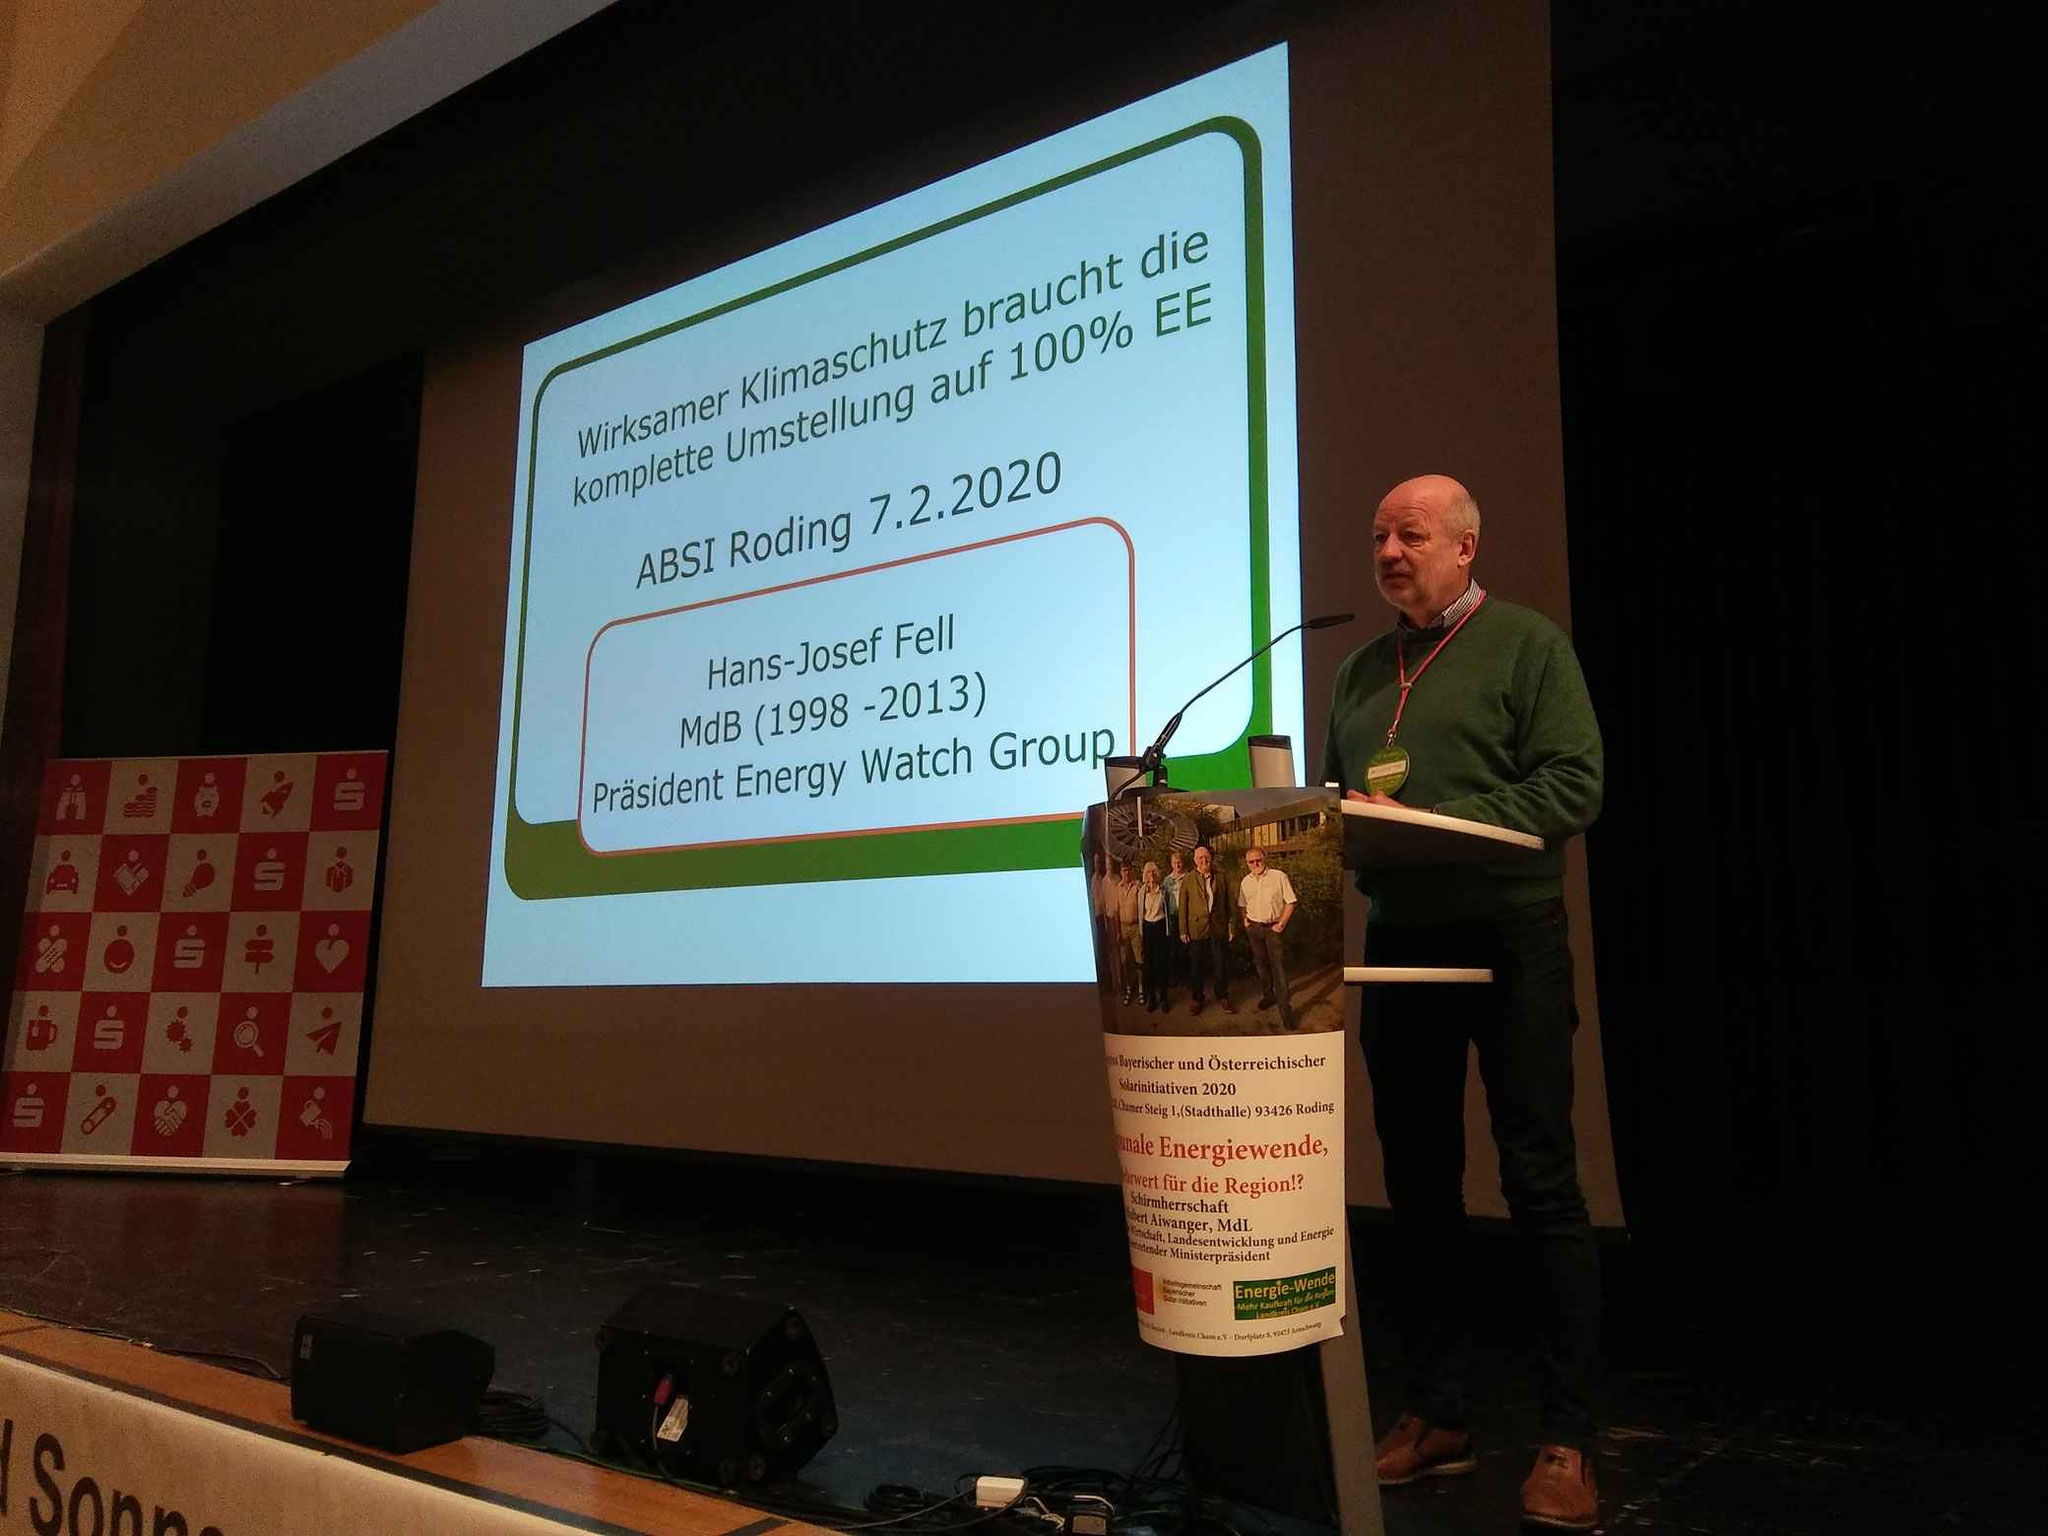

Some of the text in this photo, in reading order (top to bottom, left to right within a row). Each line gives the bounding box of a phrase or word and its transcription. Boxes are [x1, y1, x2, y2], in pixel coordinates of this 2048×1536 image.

[577, 229, 1210, 459] Wirksamer Klimaschutz braucht die
[573, 282, 1213, 508] komplette Umstellung auf 100% EE
[635, 450, 1063, 590] ABSI Roding 7.2.2020
[707, 613, 955, 691] Hans-Josef Fell
[679, 670, 987, 749] MdB (1998 -2013)
[593, 727, 1116, 813] Präsident Energy Watch Group
[1119, 1054, 1175, 1072] Bayerischer
[1178, 1056, 1204, 1071] und
[1208, 1054, 1326, 1071] Österreichischer
[1119, 1077, 1237, 1096] Solarinitiativen 2020
[1145, 1103, 1168, 1119] Steig
[1255, 1104, 1293, 1117] 93426
[1296, 1101, 1335, 1115] Roding
[1159, 1133, 1328, 1167] Energiewende,
[1122, 1166, 1304, 1199] hrwert für die Region!?
[1131, 1191, 1229, 1214] Schirmherrschaft
[1150, 1213, 1213, 1234] Aiwanger,
[1217, 1218, 1253, 1232] MdL
[1167, 1232, 1275, 1249] Landesentwicklung
[1277, 1232, 1298, 1245] und
[1300, 1226, 1335, 1243] Energie
[1170, 1248, 1270, 1265] Ministerpräsident
[1234, 1272, 1335, 1300] Energie-Wende
